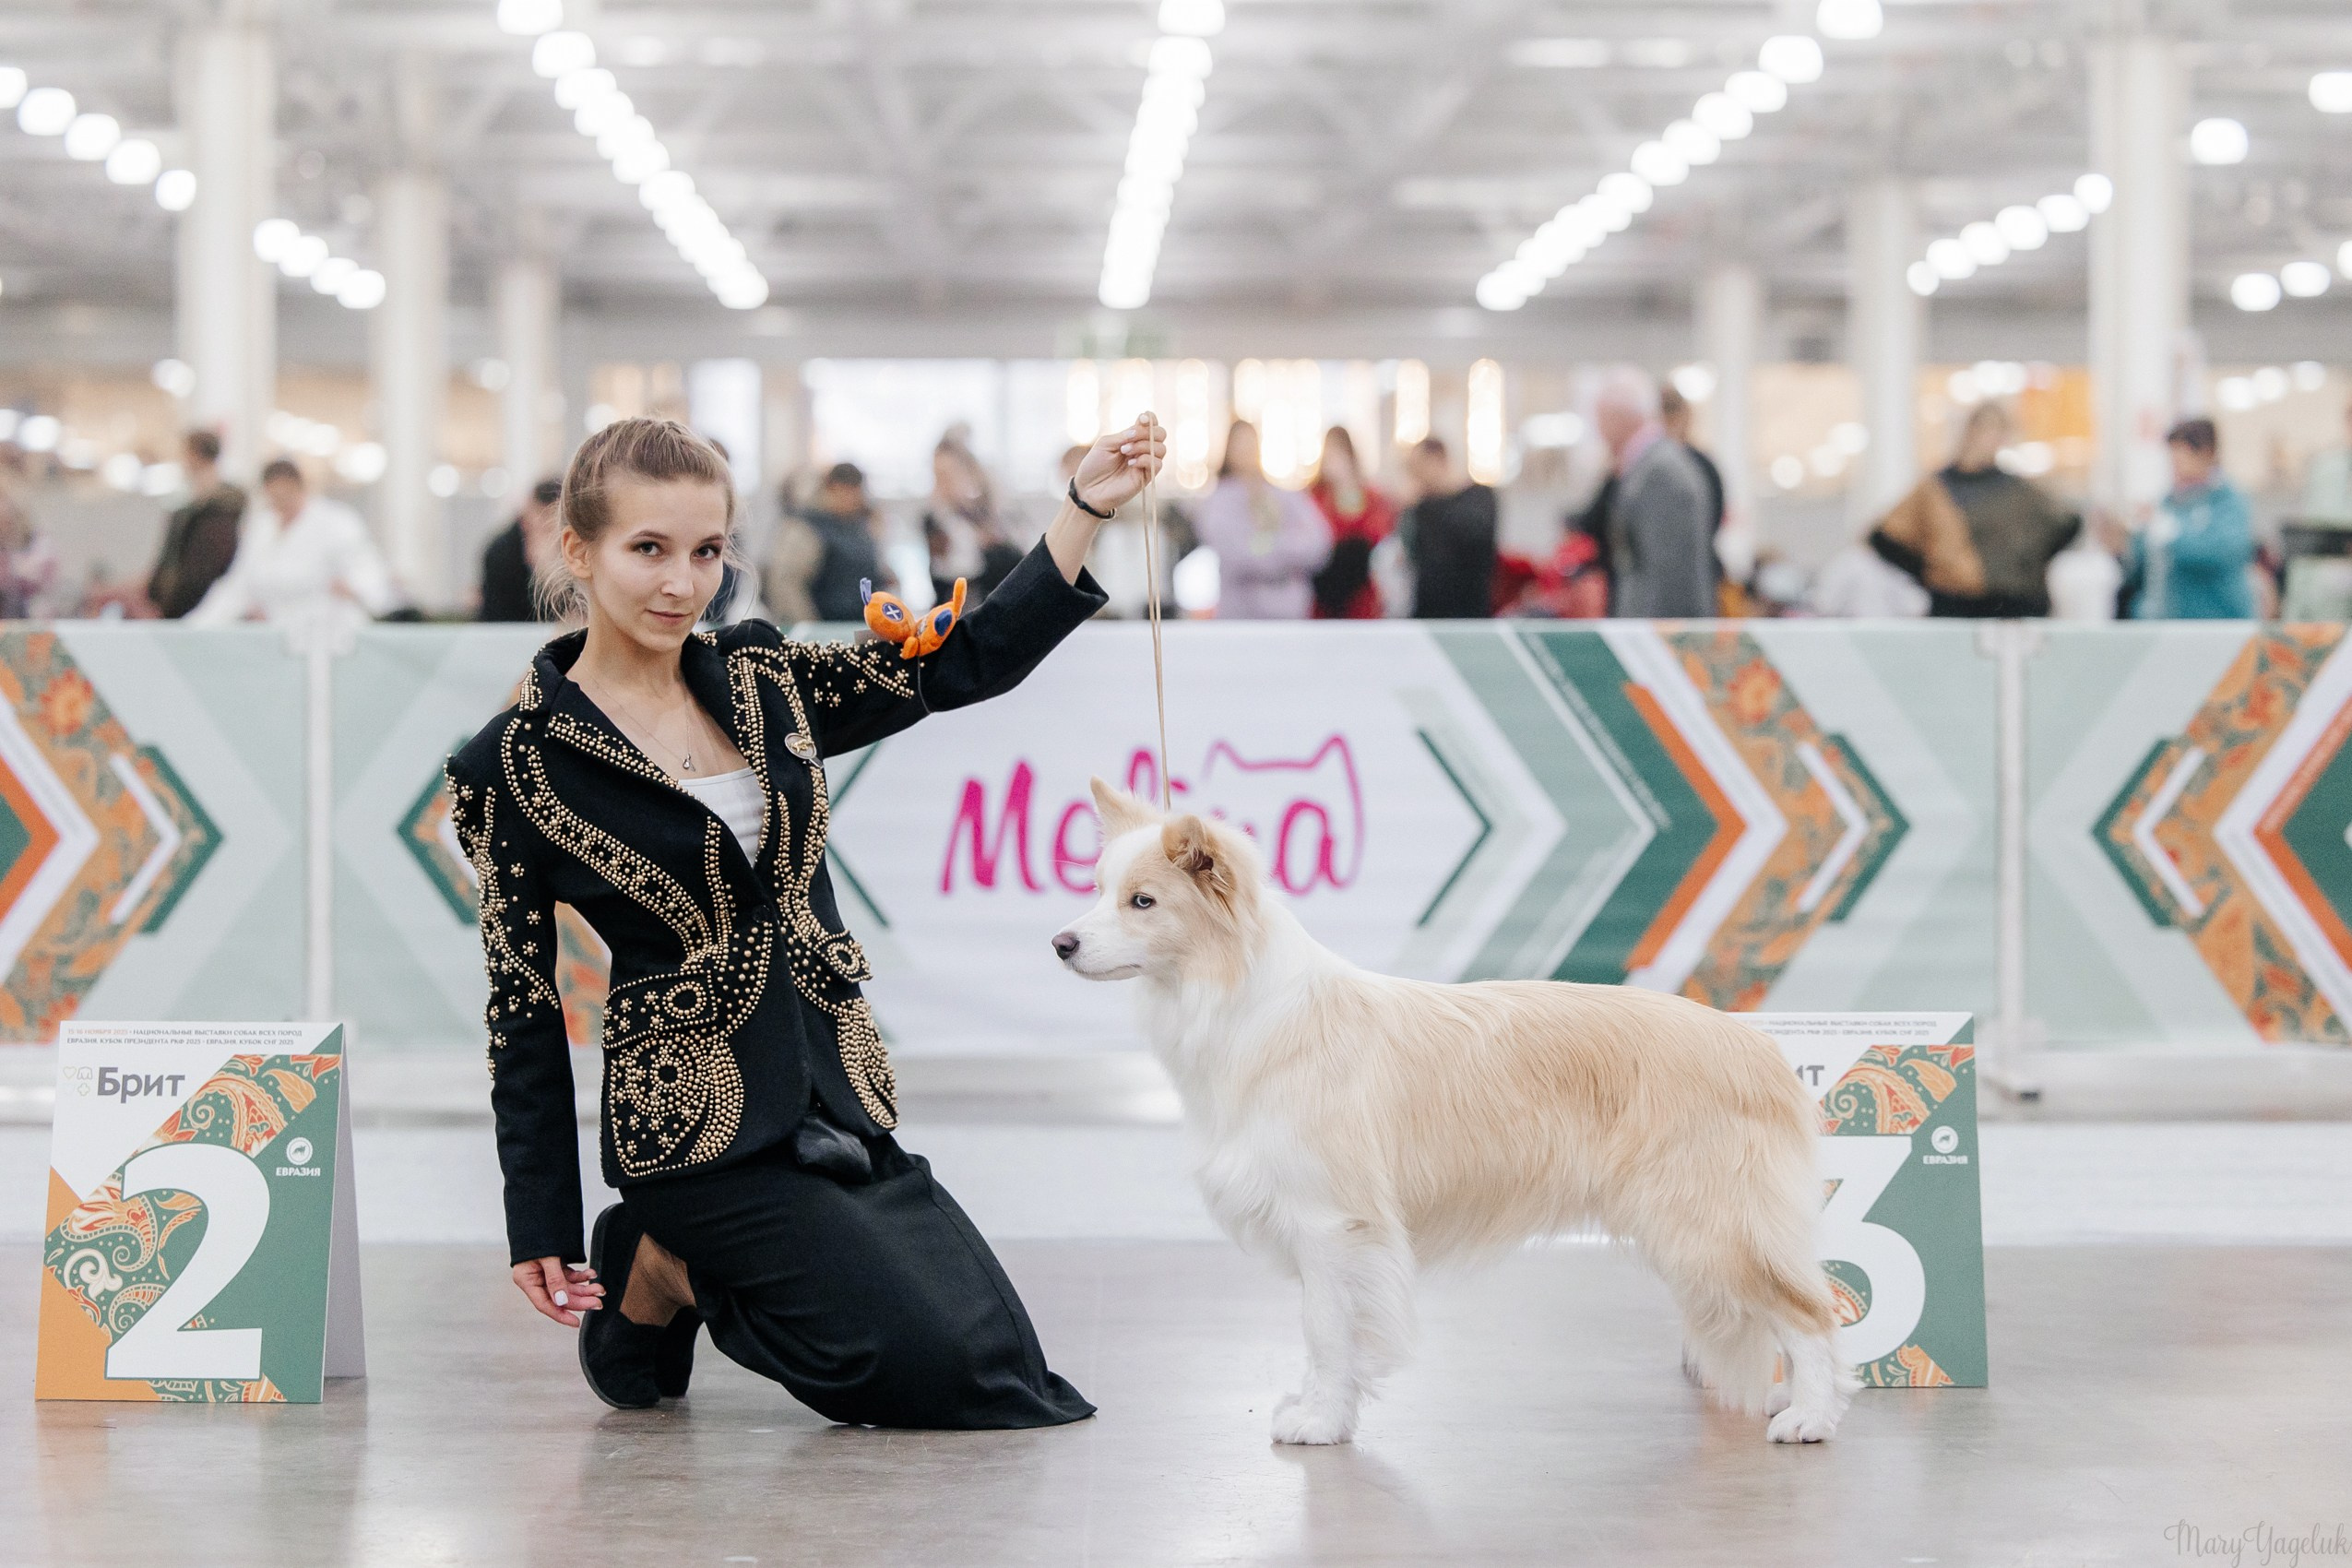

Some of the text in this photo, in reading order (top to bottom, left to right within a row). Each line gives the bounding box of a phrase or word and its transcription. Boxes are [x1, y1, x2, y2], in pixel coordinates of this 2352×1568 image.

[97, 1066, 185, 1104] Брит
[275, 1167, 321, 1177] ЕВРАЗИЯ
[105, 1143, 270, 1380] 2
[1815, 1135, 1926, 1366] 3
